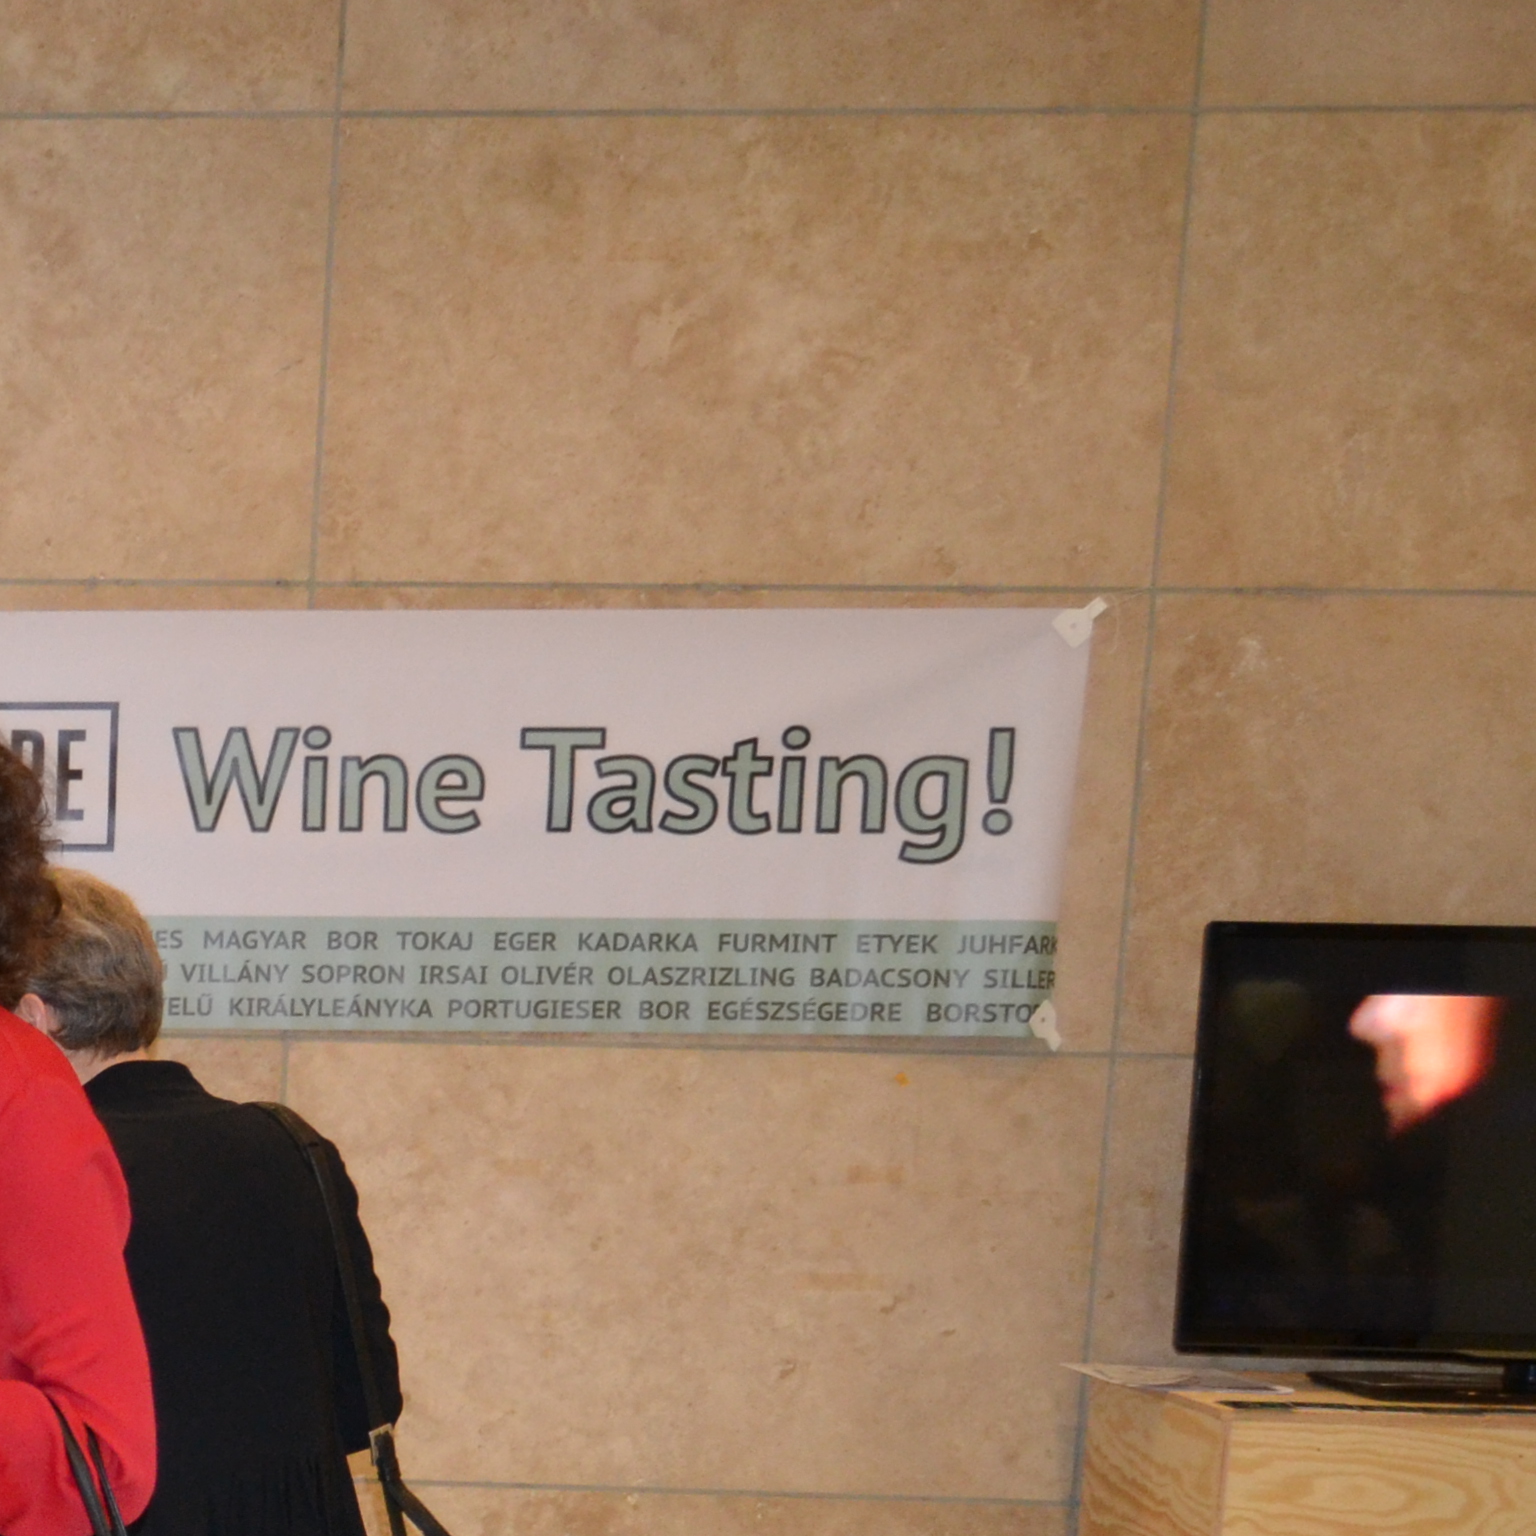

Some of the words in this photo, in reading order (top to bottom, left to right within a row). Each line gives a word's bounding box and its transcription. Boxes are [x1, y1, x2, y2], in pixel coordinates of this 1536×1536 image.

[171, 724, 486, 834] Wine
[518, 723, 1018, 865] Tasting!
[203, 930, 307, 950] MAGYAR
[327, 931, 378, 951] BOR
[396, 931, 474, 951] TOKAJ
[493, 932, 557, 951] EGER
[578, 932, 699, 952] KADARKA
[718, 933, 838, 954] FURMINT
[855, 934, 939, 955] ETYEK
[956, 934, 1058, 955] JUHFARK
[180, 959, 289, 984] VILLÁNY
[301, 964, 405, 985] SOPRON
[419, 965, 488, 986] IRSAI
[500, 962, 594, 986] OLIVÉR
[607, 966, 795, 988] OLASZRIZLING
[809, 967, 970, 989] BADACSONY
[983, 968, 1056, 990] SILLER
[228, 993, 434, 1019] KIRÁLYLEÁNYKA
[447, 999, 622, 1020] PORTUGIESER
[638, 1000, 691, 1021] BOR
[706, 997, 902, 1023] EGÉSZSÉGEDRE
[927, 1003, 1040, 1024] BORSTO
